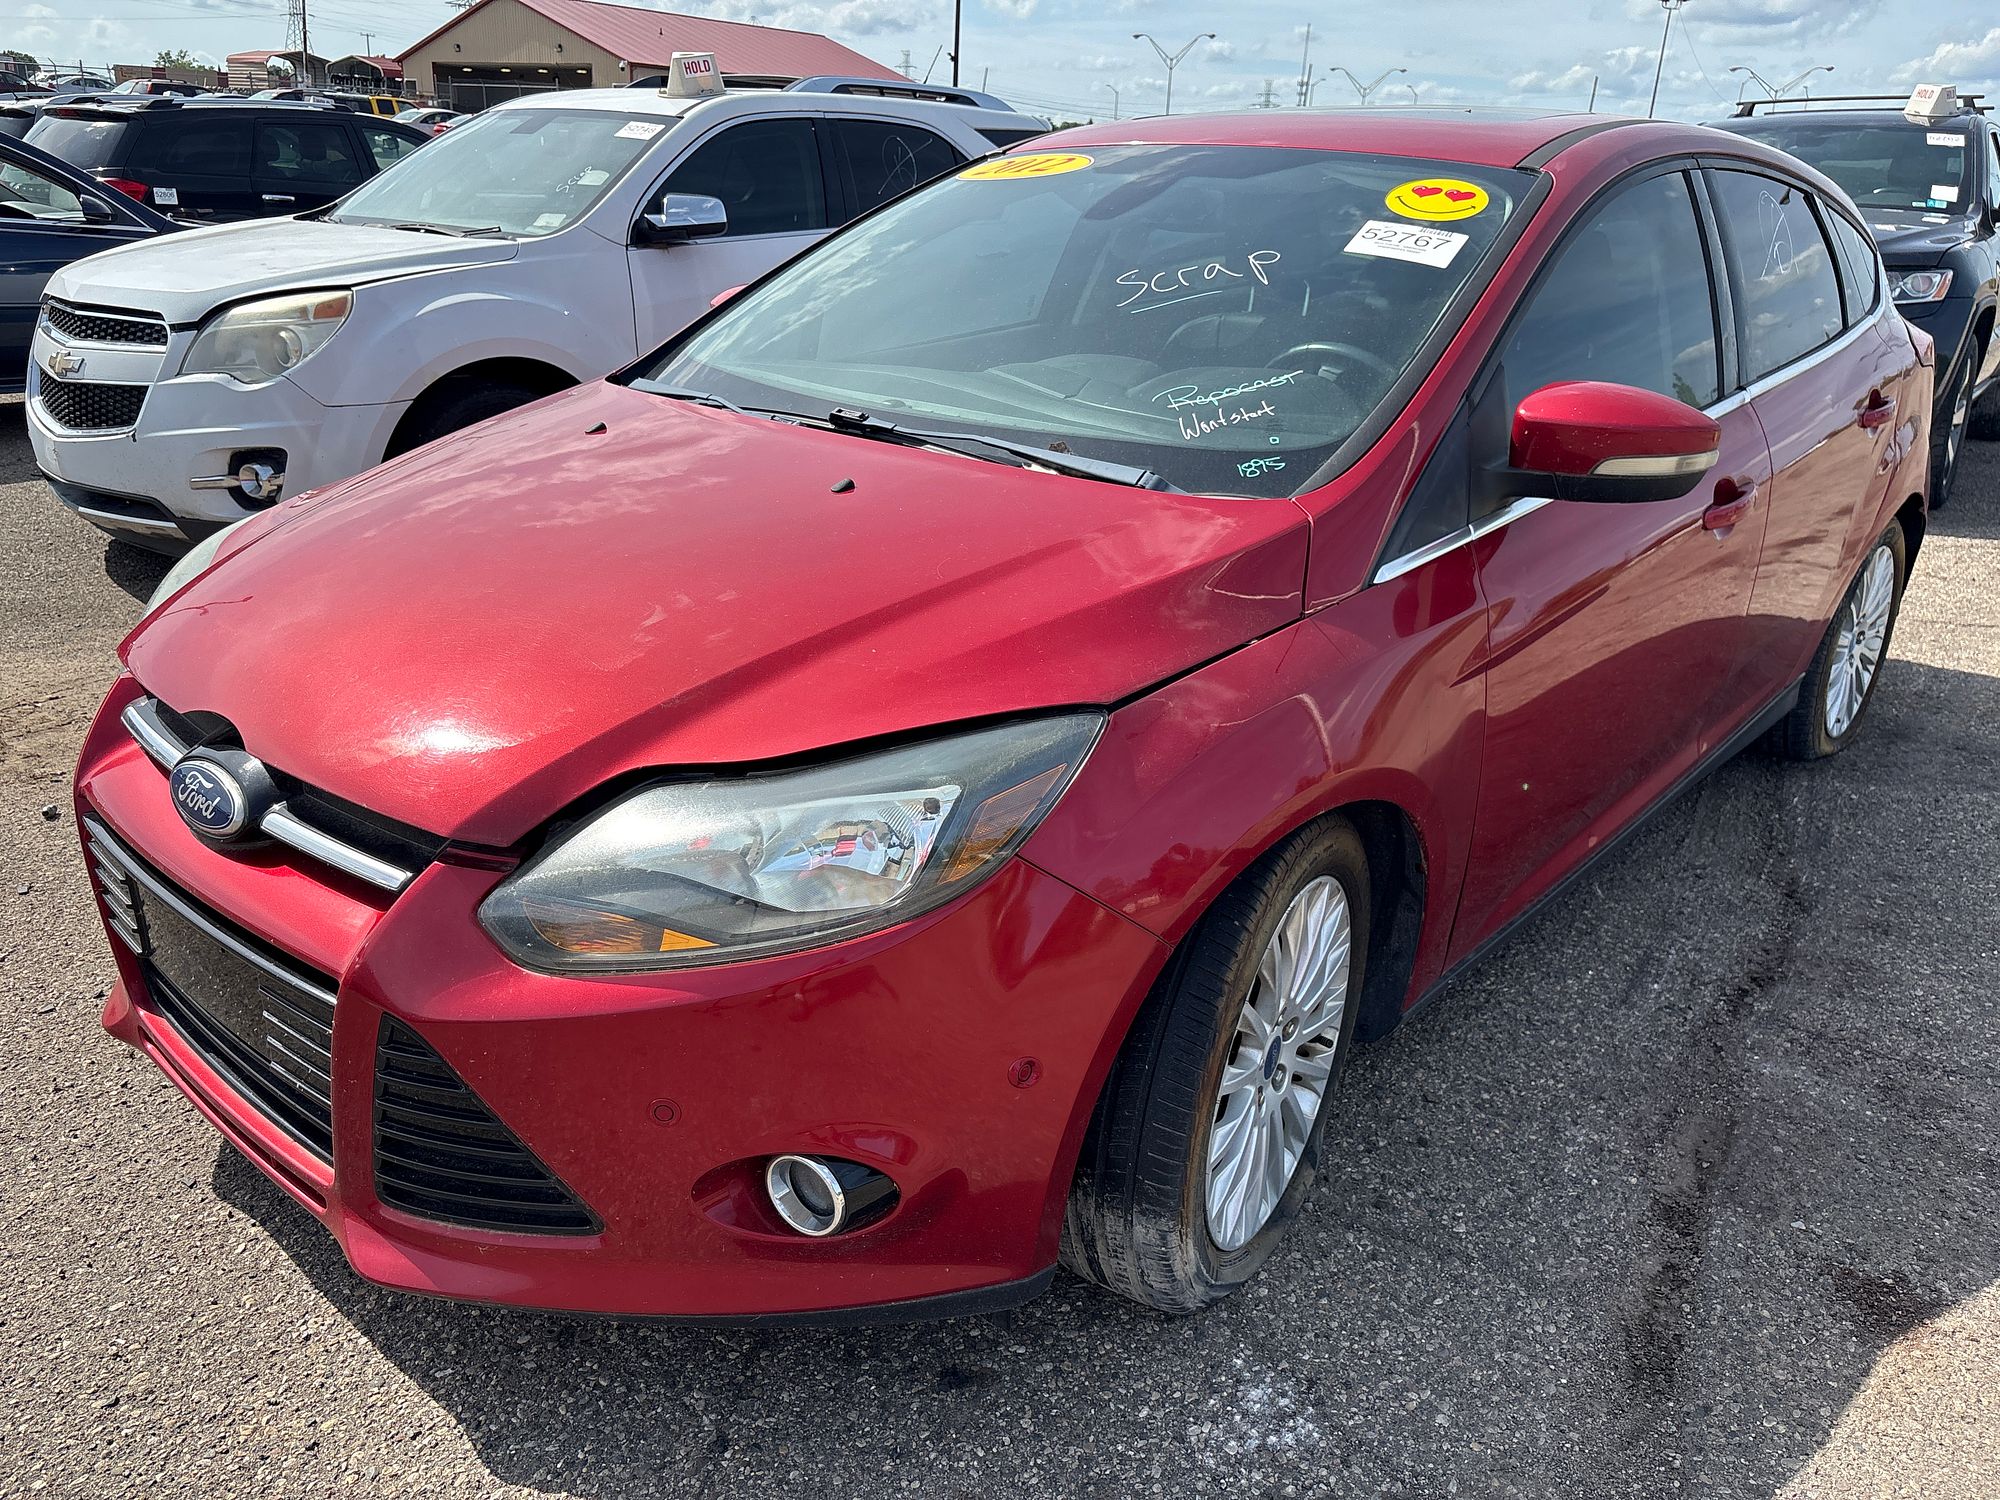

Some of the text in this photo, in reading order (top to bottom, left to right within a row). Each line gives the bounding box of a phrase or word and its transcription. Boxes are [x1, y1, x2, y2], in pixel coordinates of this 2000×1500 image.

[683, 59, 711, 75] HOLD
[1915, 89, 1935, 99] HOLD
[1361, 227, 1453, 250] 52767
[1236, 456, 1286, 478] 1895
[178, 770, 222, 819] Ford
